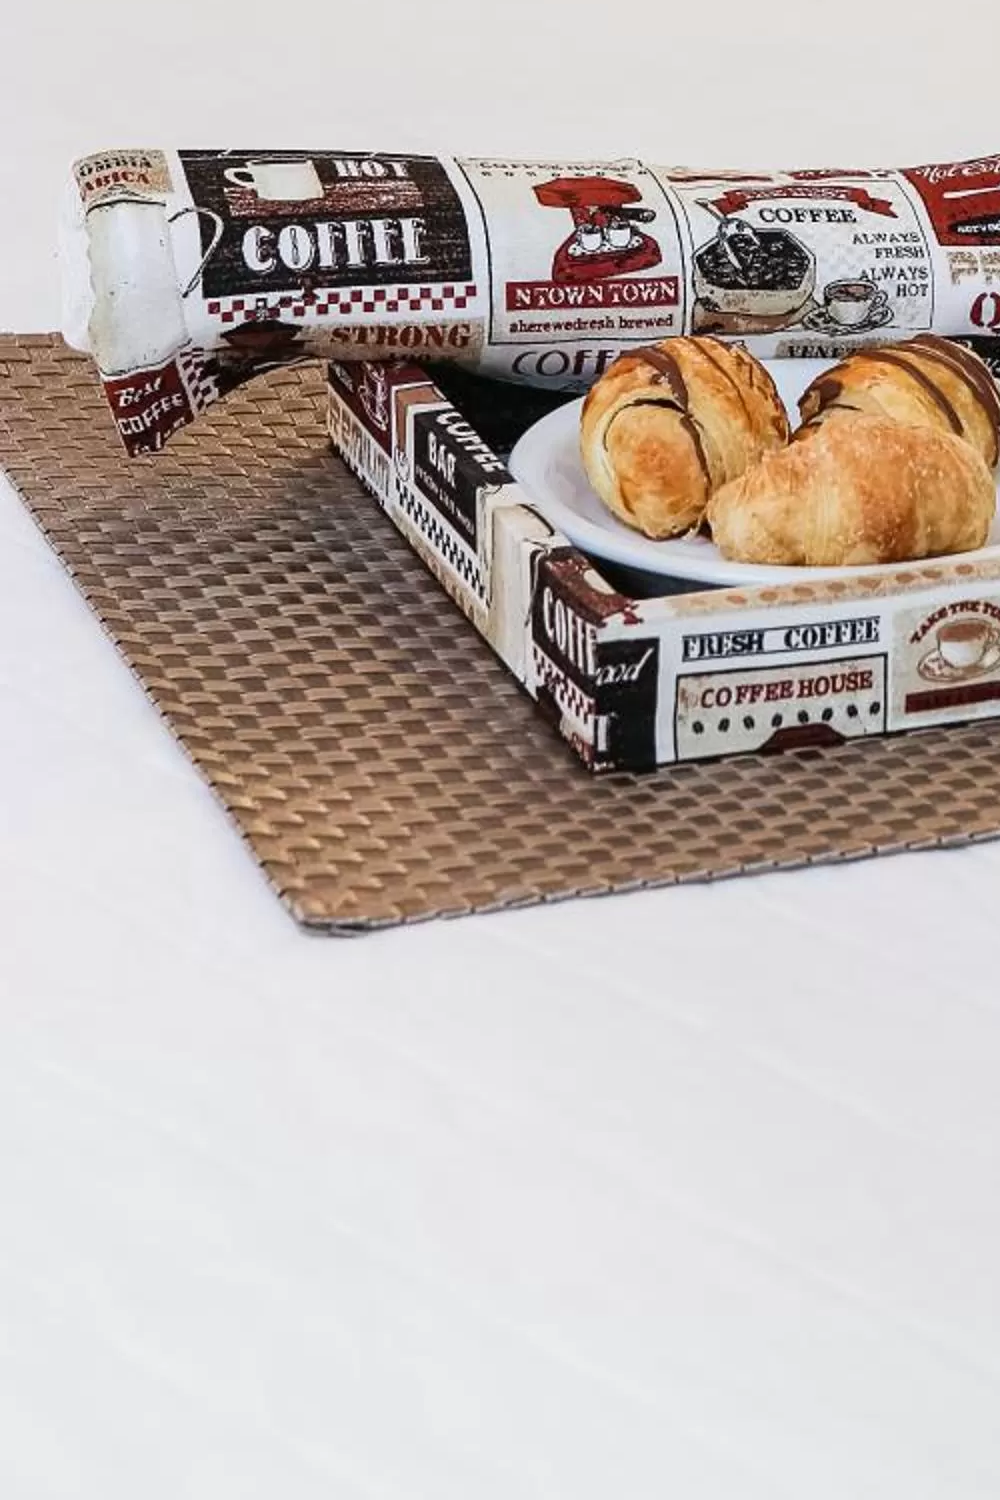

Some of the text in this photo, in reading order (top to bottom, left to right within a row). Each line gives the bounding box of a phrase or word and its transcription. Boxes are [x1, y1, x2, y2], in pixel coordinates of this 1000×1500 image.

[333, 159, 408, 177] HOT
[759, 207, 857, 224] COFFEE
[242, 217, 430, 274] COFFEE
[852, 232, 921, 245] ALWAYS
[875, 246, 926, 260] FRESH
[860, 266, 929, 281] ALWAYS
[607, 280, 677, 304] TOWN
[896, 283, 929, 298] HOT
[619, 314, 674, 330] brewed
[330, 323, 471, 349] STRONG
[117, 393, 185, 436] COFFEE
[427, 430, 457, 489] BAR
[910, 606, 950, 644] TAKE
[948, 601, 982, 616] THE
[682, 616, 880, 662] FRESH COFFEE
[701, 669, 873, 709] COFFEE HOUSE
